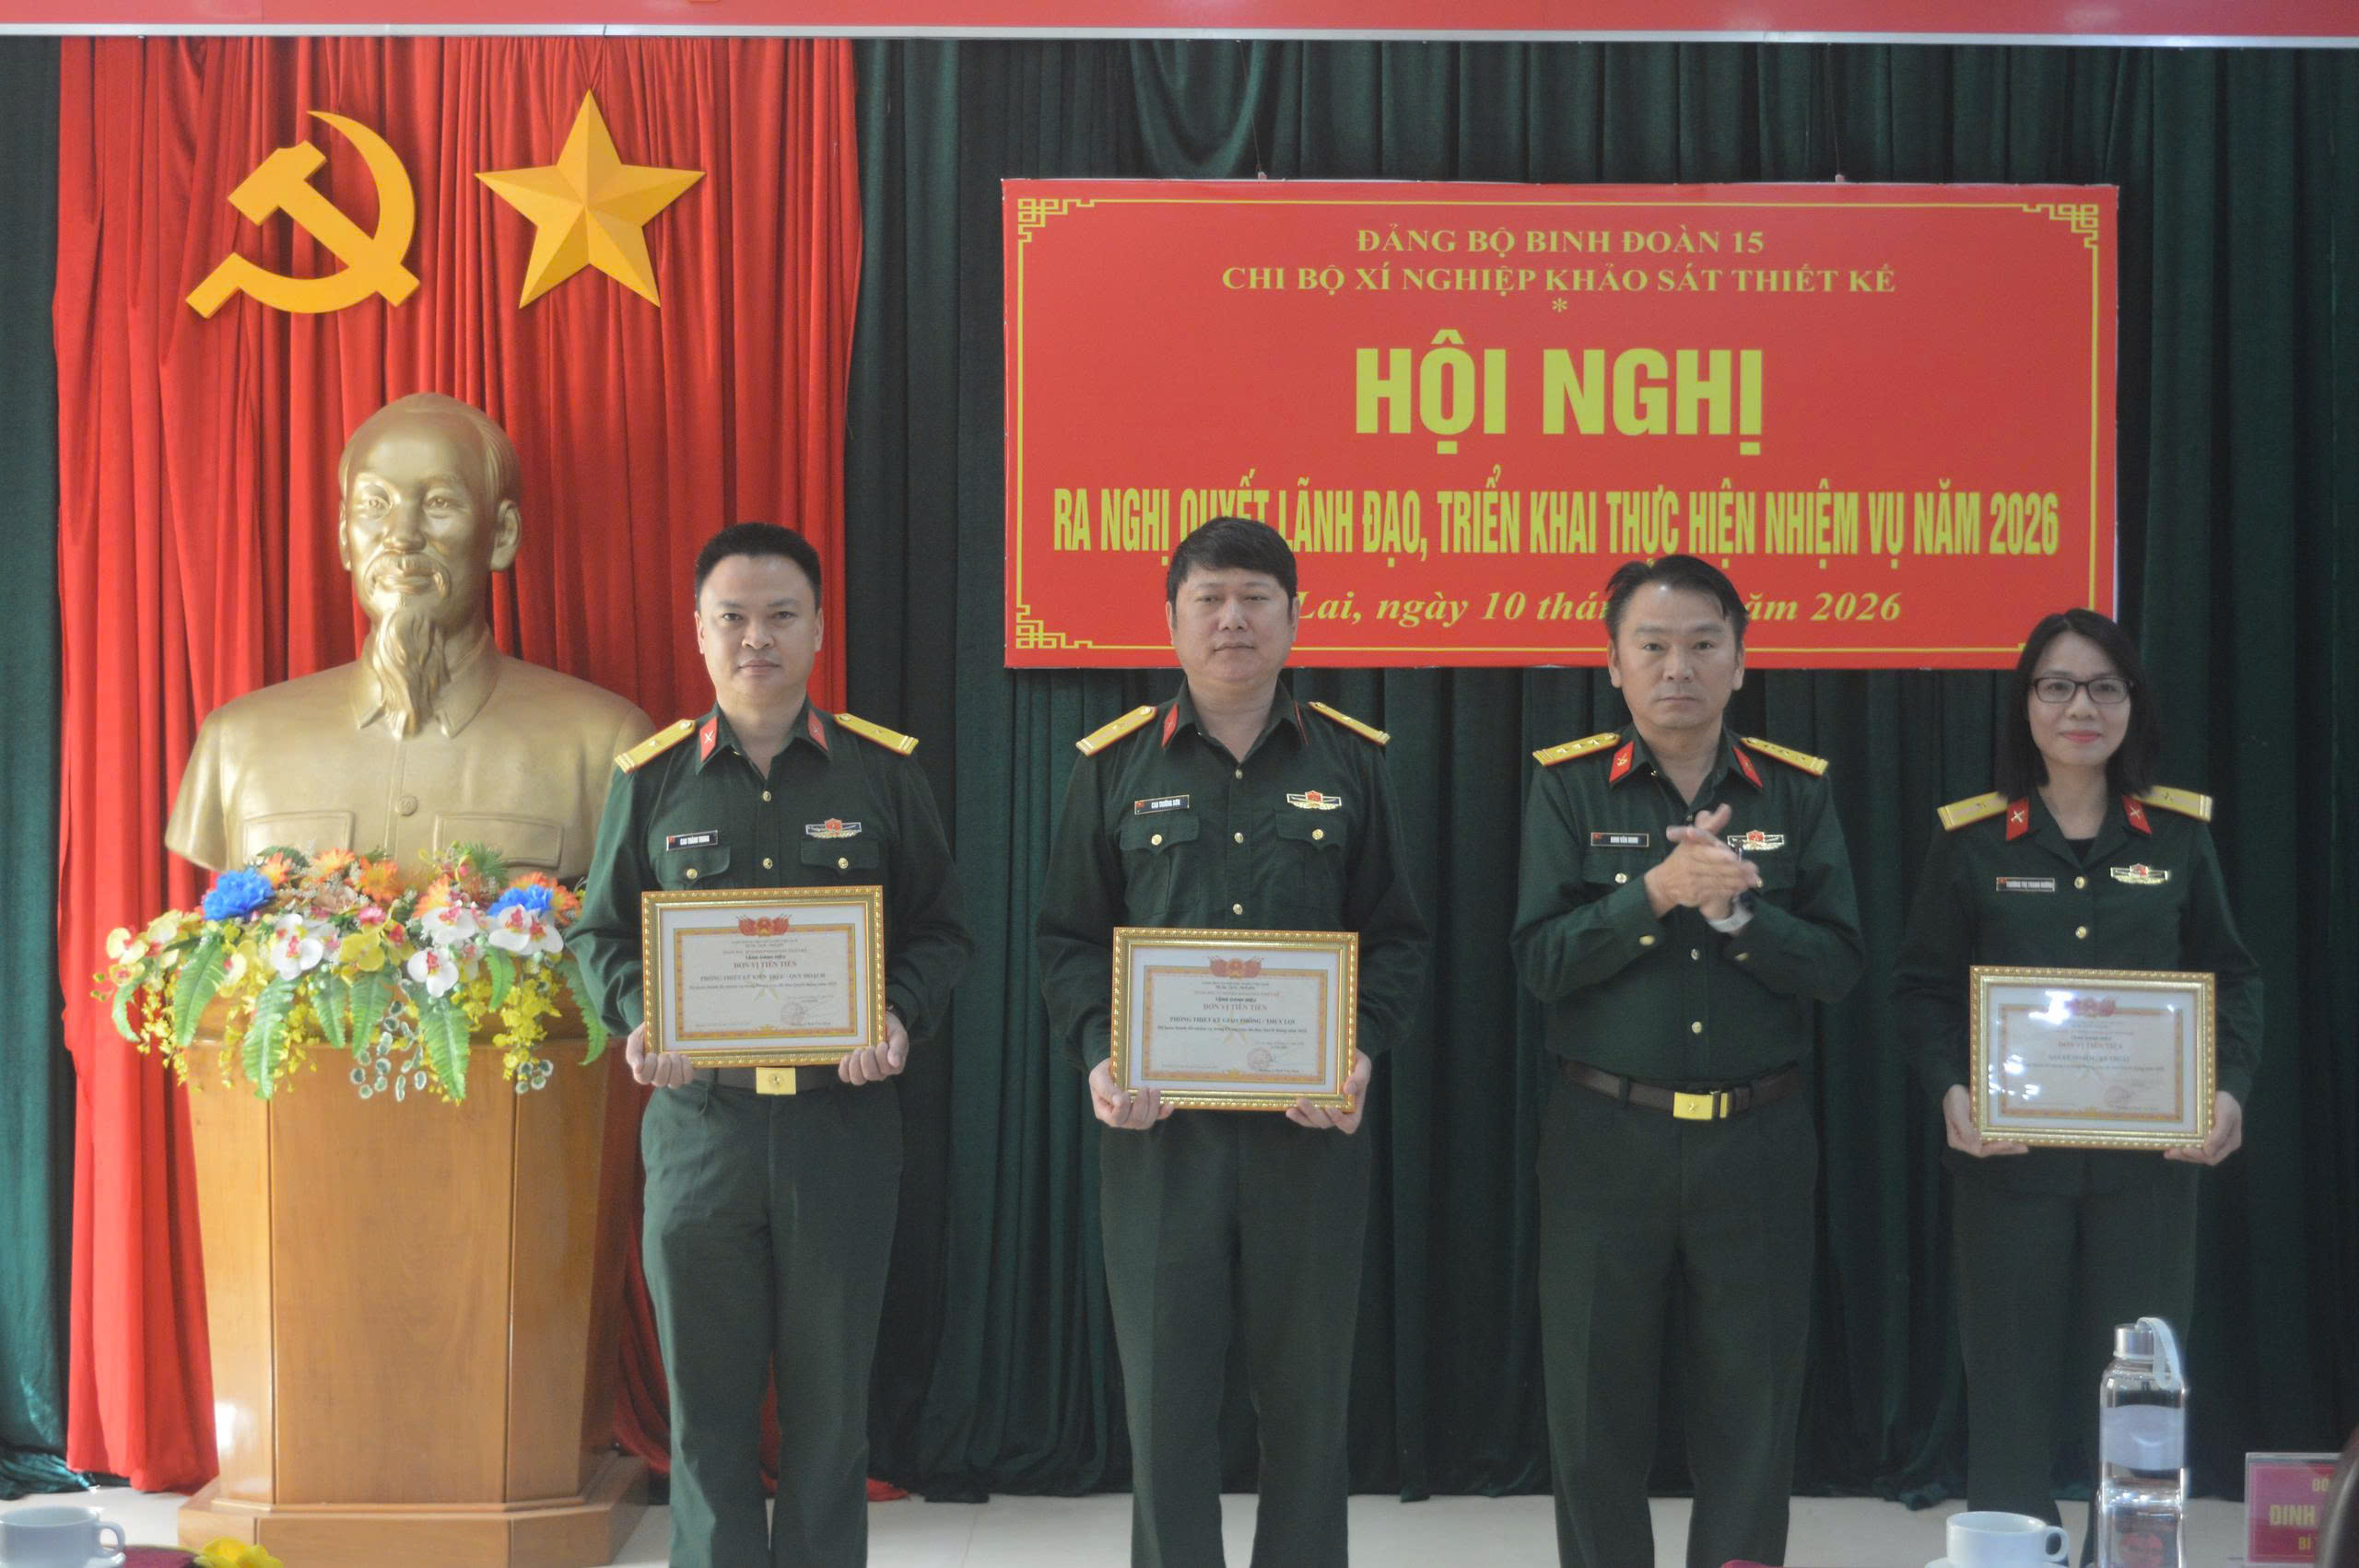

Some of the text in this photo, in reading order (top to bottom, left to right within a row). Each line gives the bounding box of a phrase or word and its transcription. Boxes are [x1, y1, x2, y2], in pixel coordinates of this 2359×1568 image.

[1357, 224, 1764, 258] ĐẢNG BỘ BINH ĐOÀN 15
[1223, 262, 1895, 296] CHI BỘ XÍ NGHIỆP KHẢO SÁT THIẾT KẾ
[1356, 329, 1763, 455] HỘI NGHỊ
[1053, 487, 1091, 552] RA
[1100, 487, 1170, 566] NGHỊ
[1278, 477, 1353, 553] LÃNH
[1362, 490, 1428, 568] ĐẠO,
[1437, 464, 1520, 554] TRIỂN
[1530, 491, 1596, 554] KHAI
[1606, 486, 1679, 568] THỰC
[1689, 478, 1755, 568] HIỆN
[1766, 478, 1859, 568] NHIỆM
[1869, 492, 1904, 568] VỤ
[1913, 479, 1980, 554] NĂM
[1989, 492, 2059, 555] 2026
[1376, 591, 1469, 627] ngày
[1483, 591, 1526, 620] 10
[1537, 591, 1608, 620] thá
[1744, 592, 1801, 621] ăm
[1810, 592, 1902, 621] 2026
